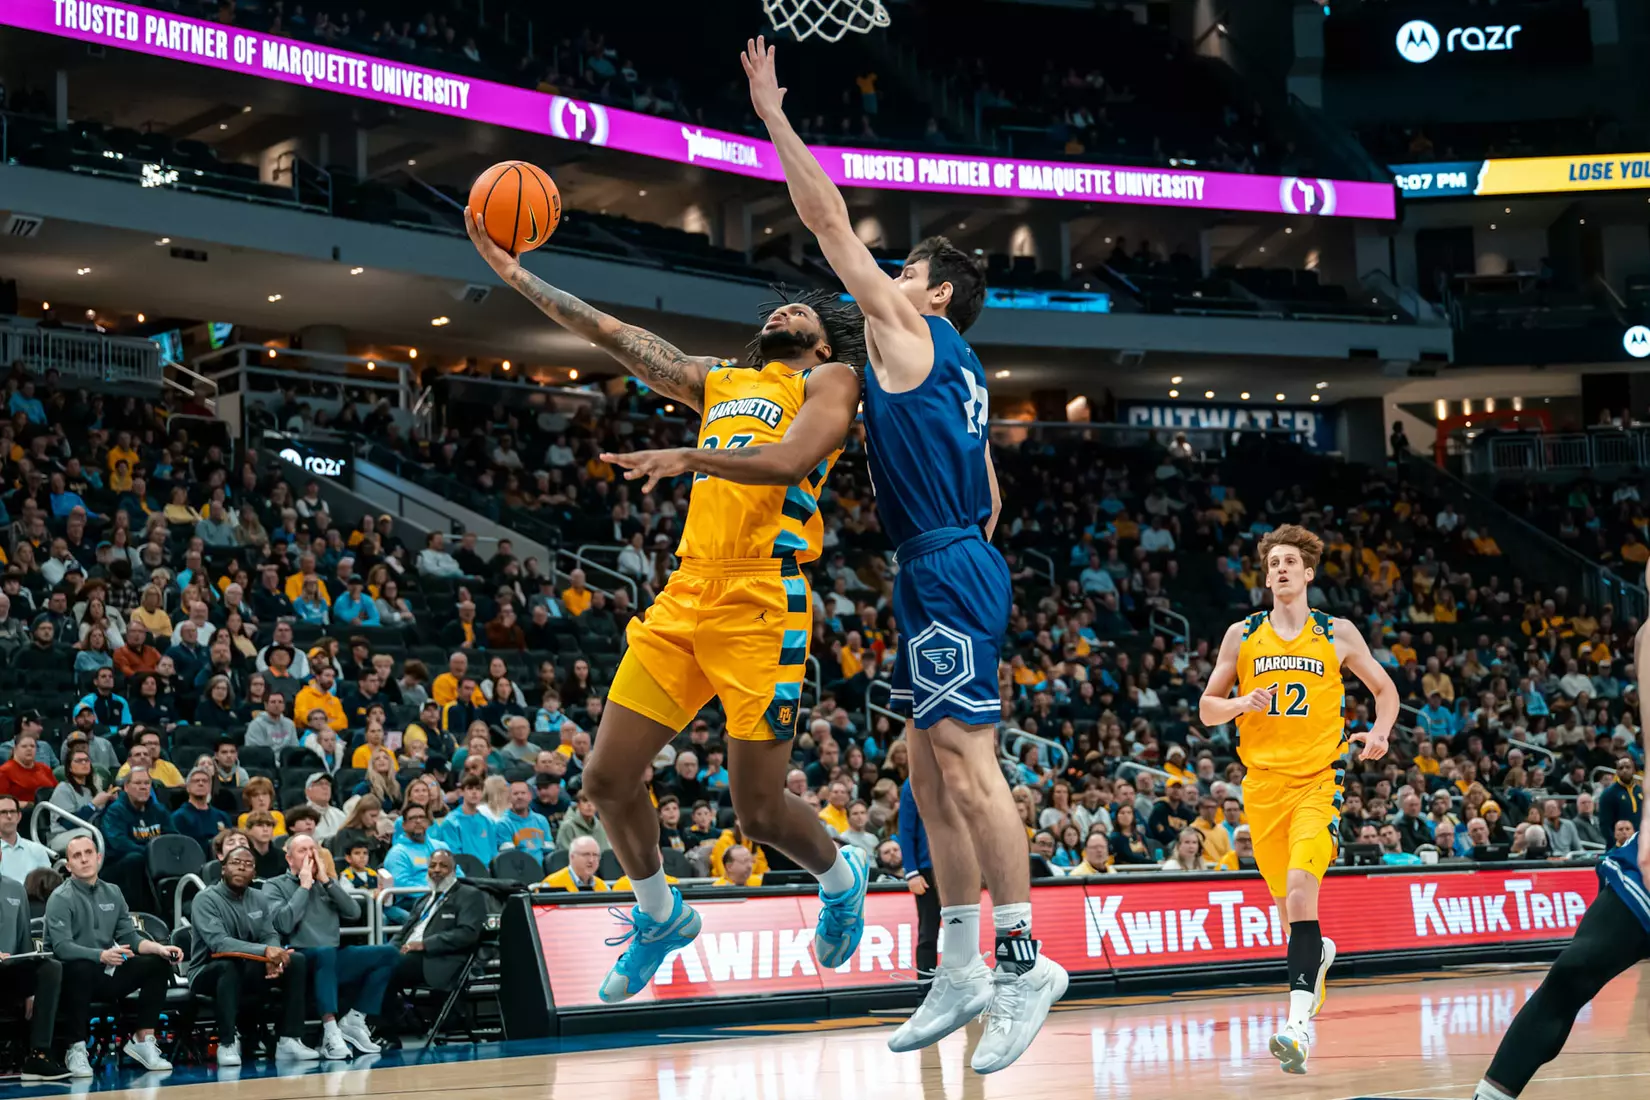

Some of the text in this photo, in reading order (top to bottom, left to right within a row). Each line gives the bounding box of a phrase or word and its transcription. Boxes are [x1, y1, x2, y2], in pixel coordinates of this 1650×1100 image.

[1446, 24, 1522, 52] razr
[54, 0, 470, 110] TRUSTED PARTNER OF MARQUETTE UNIVERSITY
[841, 152, 1205, 200] TRUSTED PARTNER OF MARQUETTE UNIVERSITY
[1436, 172, 1467, 189] PM
[1569, 162, 1614, 181] LOSE
[11, 219, 37, 236] 117
[704, 398, 783, 430] MARQUETTE
[305, 456, 346, 476] razr
[1254, 655, 1325, 677] MARQUETTE
[1266, 682, 1309, 717] 12
